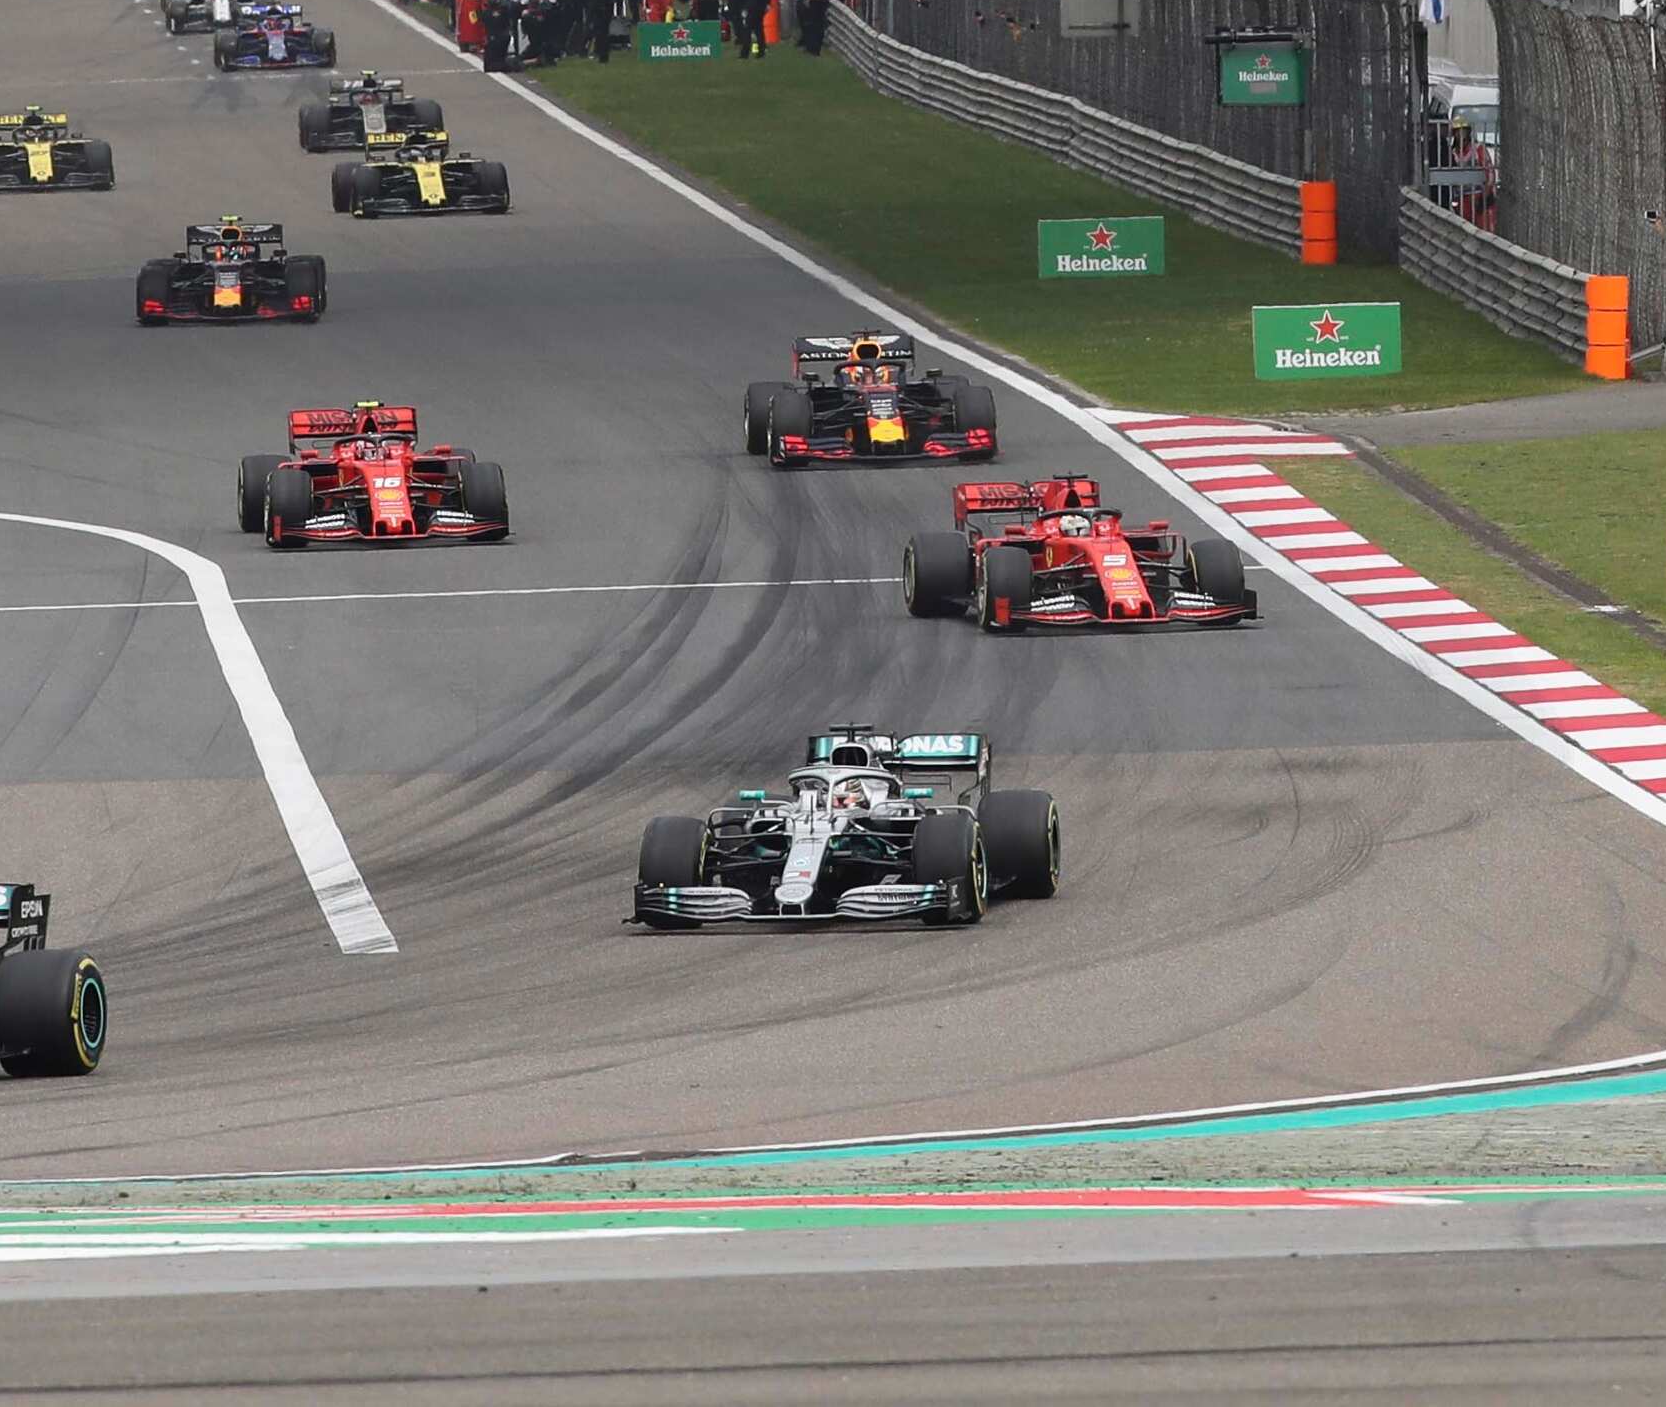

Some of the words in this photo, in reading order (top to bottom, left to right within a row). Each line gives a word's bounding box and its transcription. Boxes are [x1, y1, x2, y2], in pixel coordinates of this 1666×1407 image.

[650, 44, 711, 57] Heineken
[1238, 70, 1289, 82] Heineken
[1057, 254, 1147, 272] Heineken
[1275, 347, 1381, 368] Heineken
[372, 477, 402, 488] 16
[1102, 554, 1127, 567] 5
